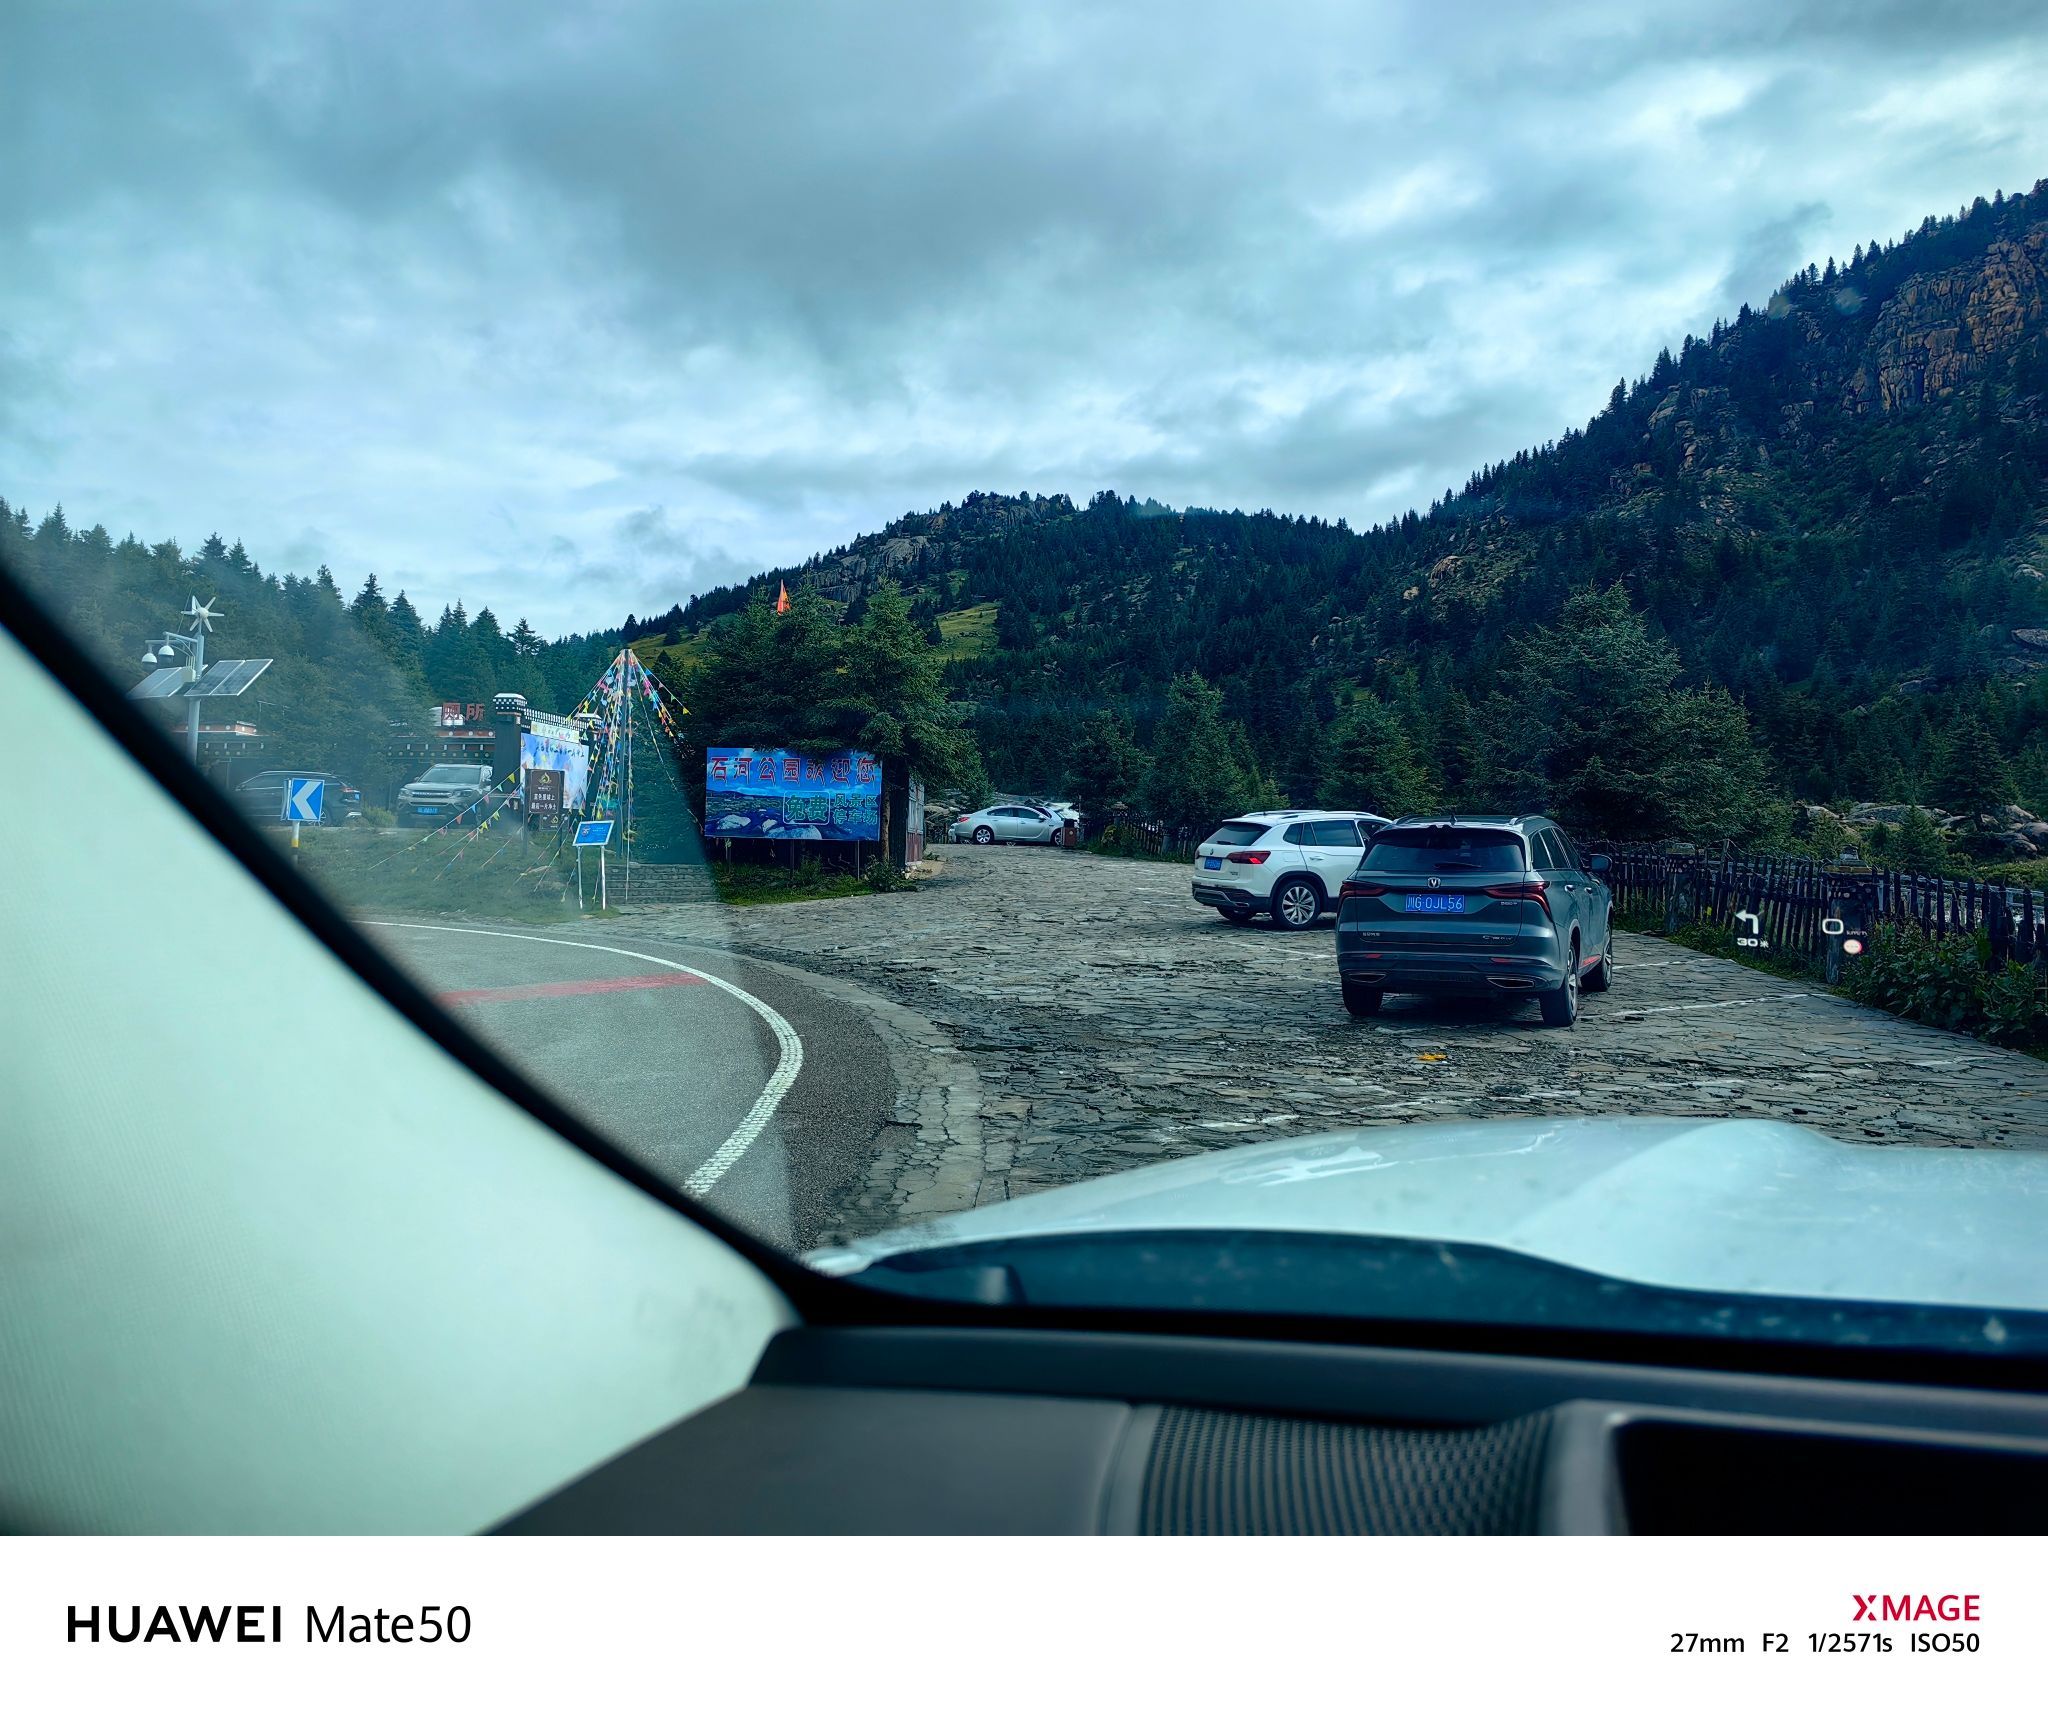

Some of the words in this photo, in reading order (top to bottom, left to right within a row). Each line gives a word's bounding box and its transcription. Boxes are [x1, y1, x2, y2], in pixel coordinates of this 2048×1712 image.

[443, 702, 485, 721] 厕所
[711, 757, 877, 786] 石河公园欢迎您
[785, 794, 828, 822] 免费
[833, 793, 878, 808] 风景区
[833, 808, 878, 825] 停车场
